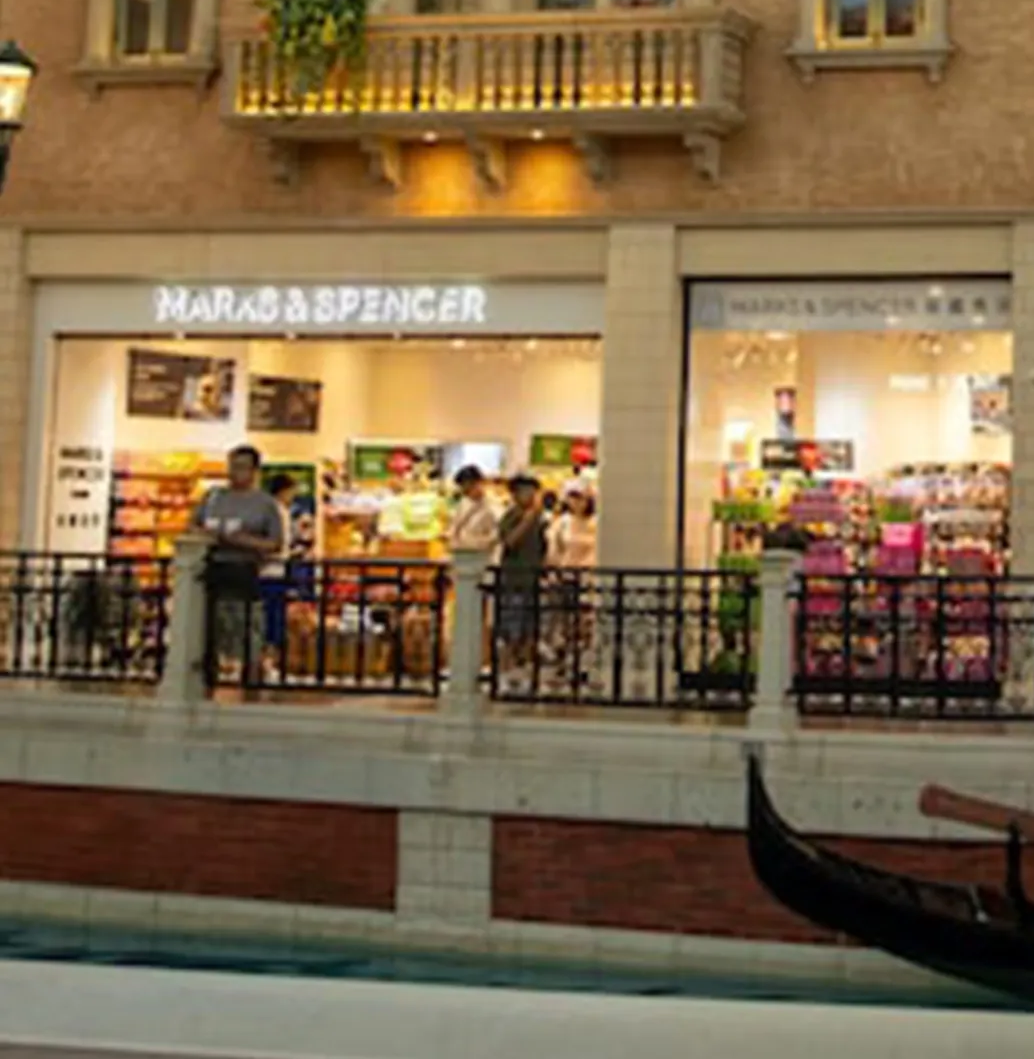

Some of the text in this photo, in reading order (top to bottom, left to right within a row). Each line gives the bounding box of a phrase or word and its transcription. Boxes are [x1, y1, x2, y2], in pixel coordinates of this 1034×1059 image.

[155, 285, 486, 324] MARKS & SPENCER
